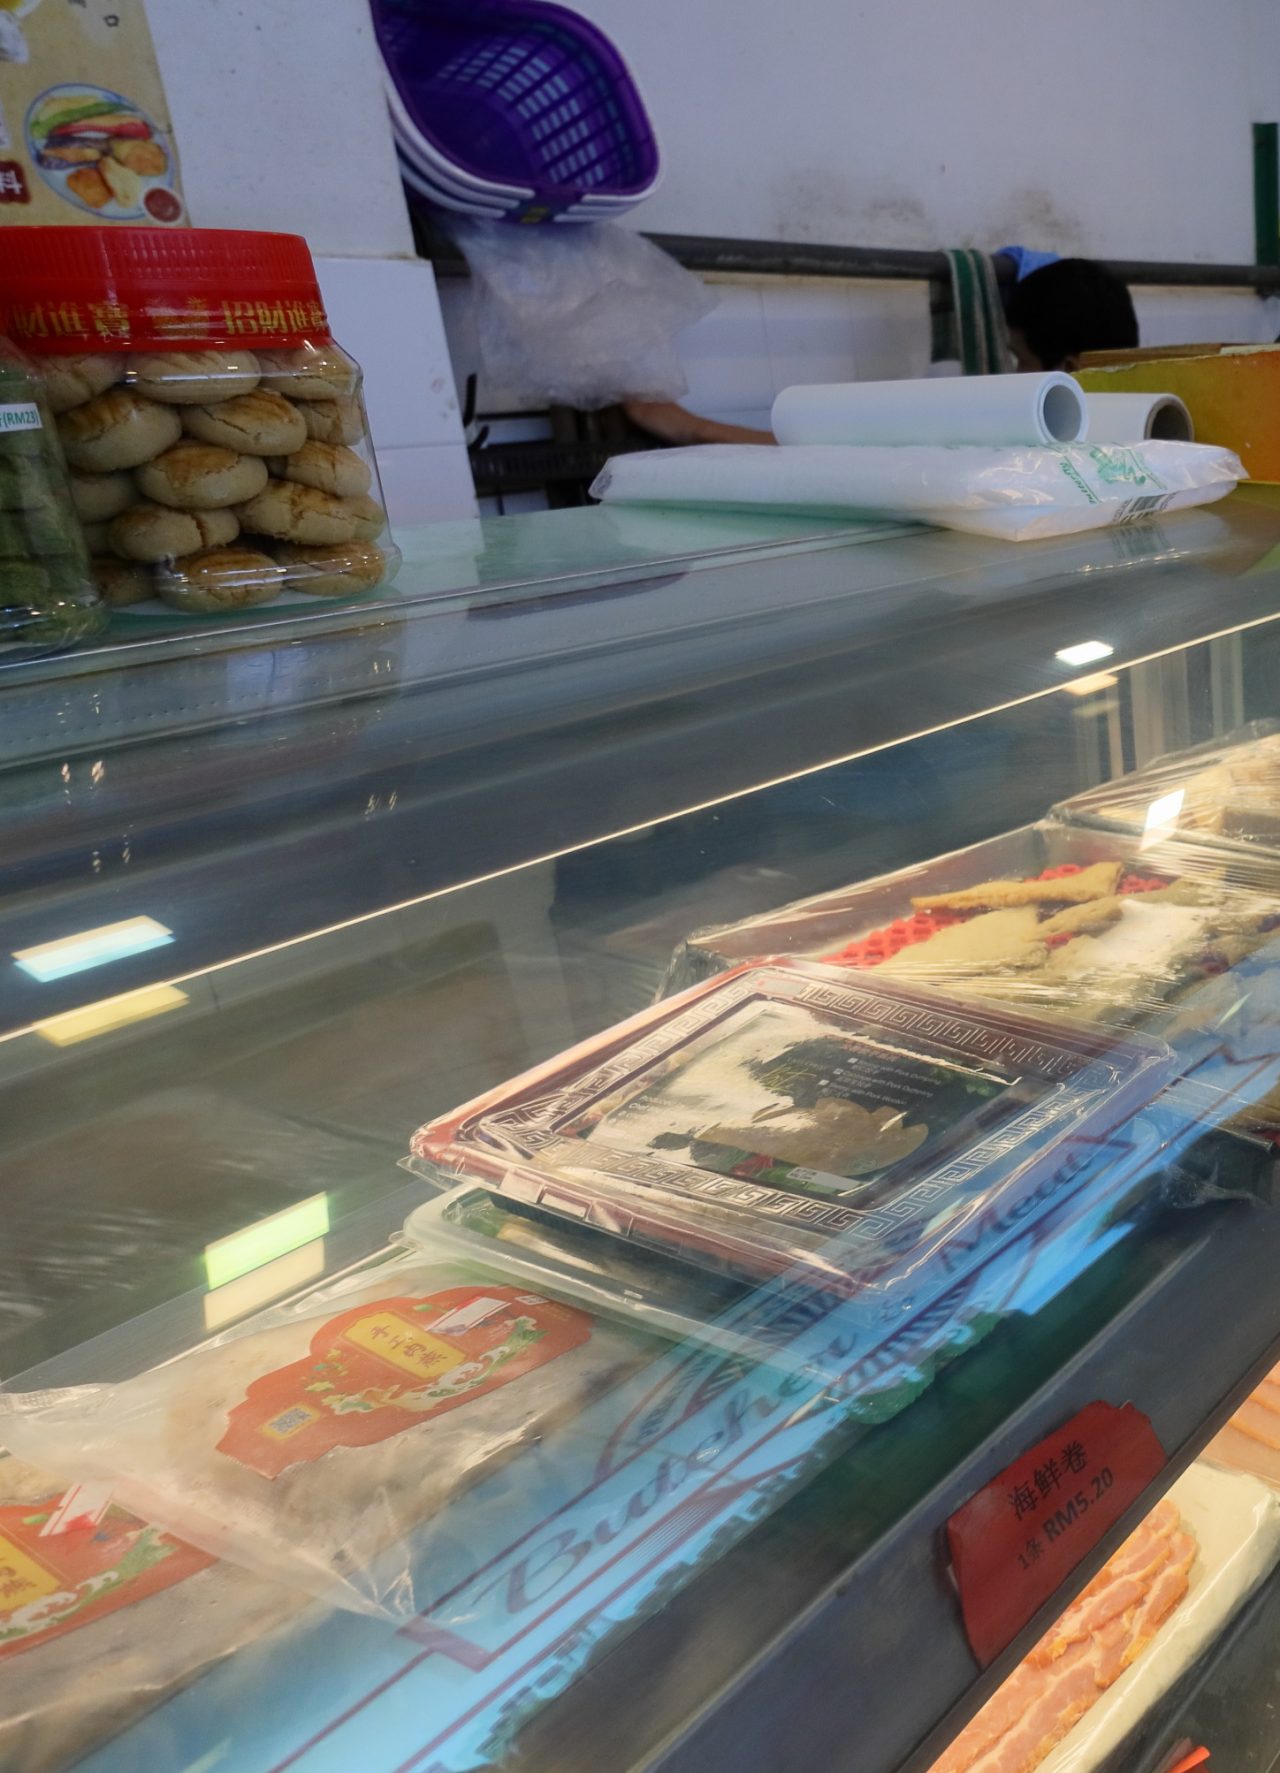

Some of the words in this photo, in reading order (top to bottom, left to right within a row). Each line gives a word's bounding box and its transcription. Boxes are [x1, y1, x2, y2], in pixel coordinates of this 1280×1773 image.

[0, 411, 40, 428] (RM23)
[1007, 1440, 1087, 1521] 海鲜卷
[1042, 1466, 1114, 1542] RM5.20
